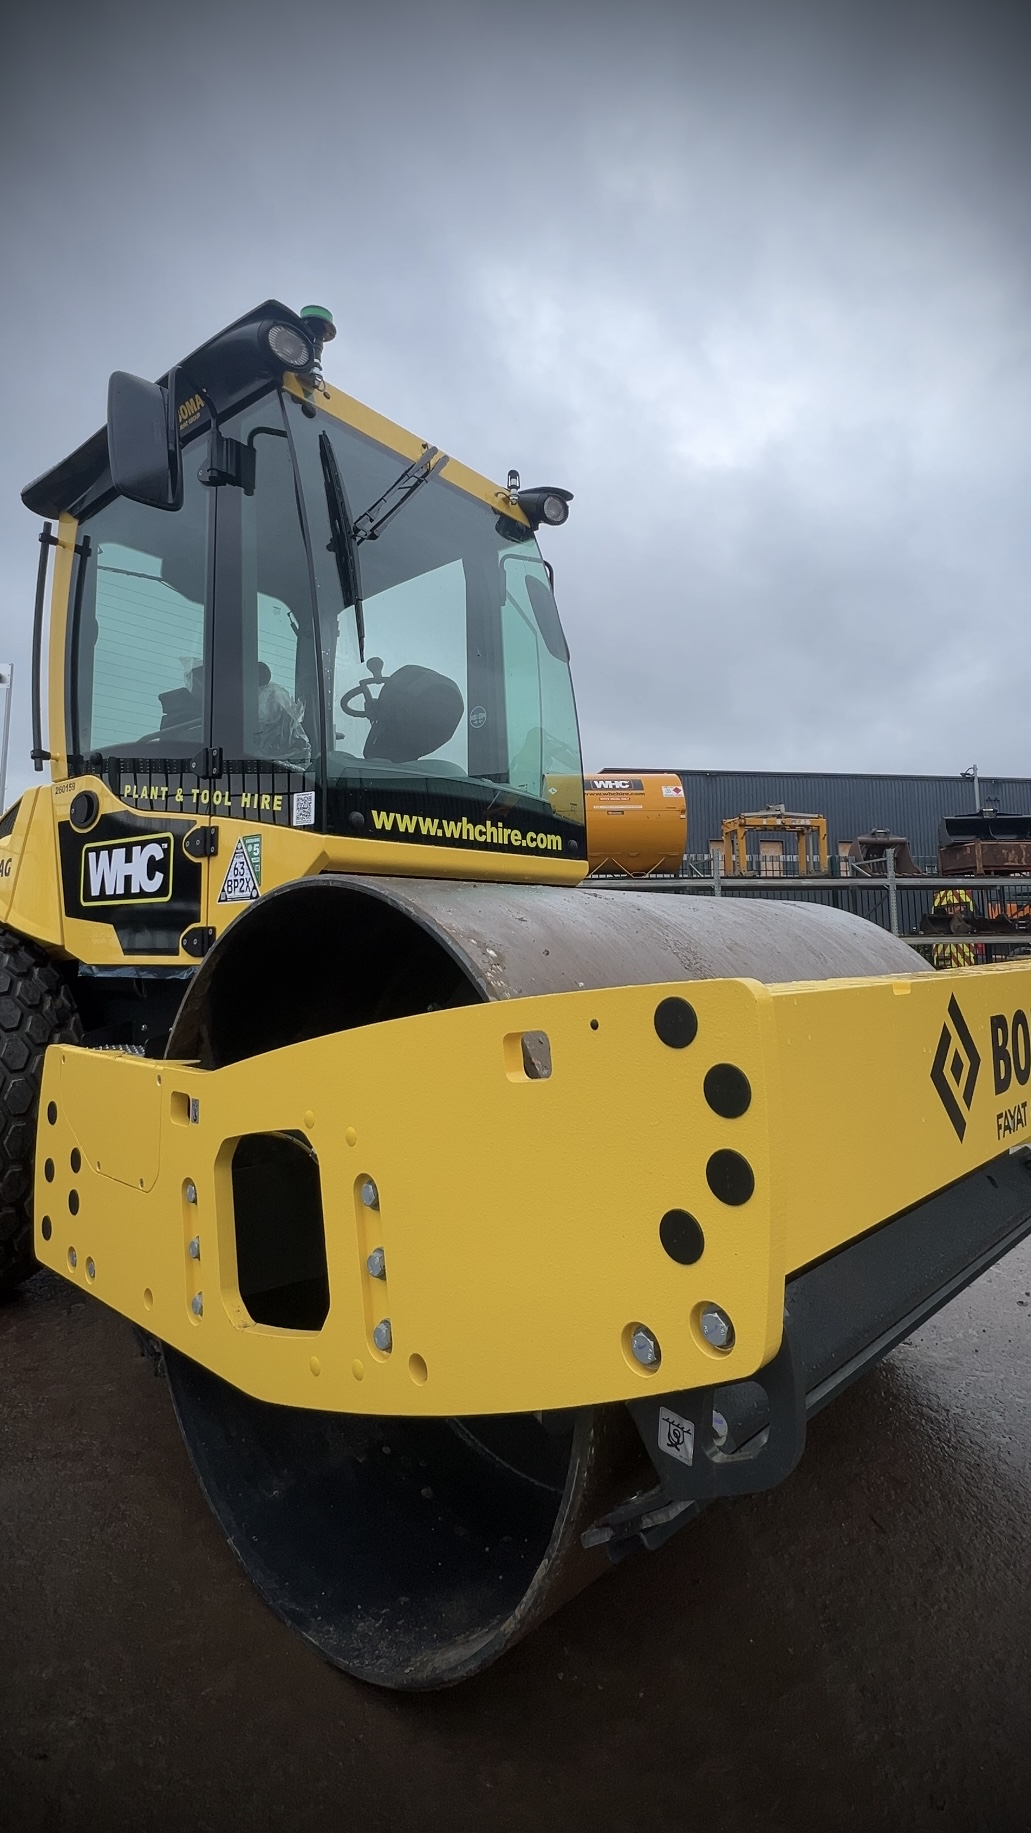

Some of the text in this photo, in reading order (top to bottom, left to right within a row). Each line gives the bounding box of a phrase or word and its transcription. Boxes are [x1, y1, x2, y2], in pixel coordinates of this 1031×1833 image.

[178, 393, 205, 423] OMA
[124, 784, 283, 811] PLANT & TOOL HIRE
[593, 780, 630, 789] WHC
[371, 809, 563, 851] www.whchire.com
[88, 843, 165, 897] WHC
[233, 861, 245, 878] 63
[989, 1008, 1031, 1097] BO
[996, 1100, 1028, 1141] FAYAT
